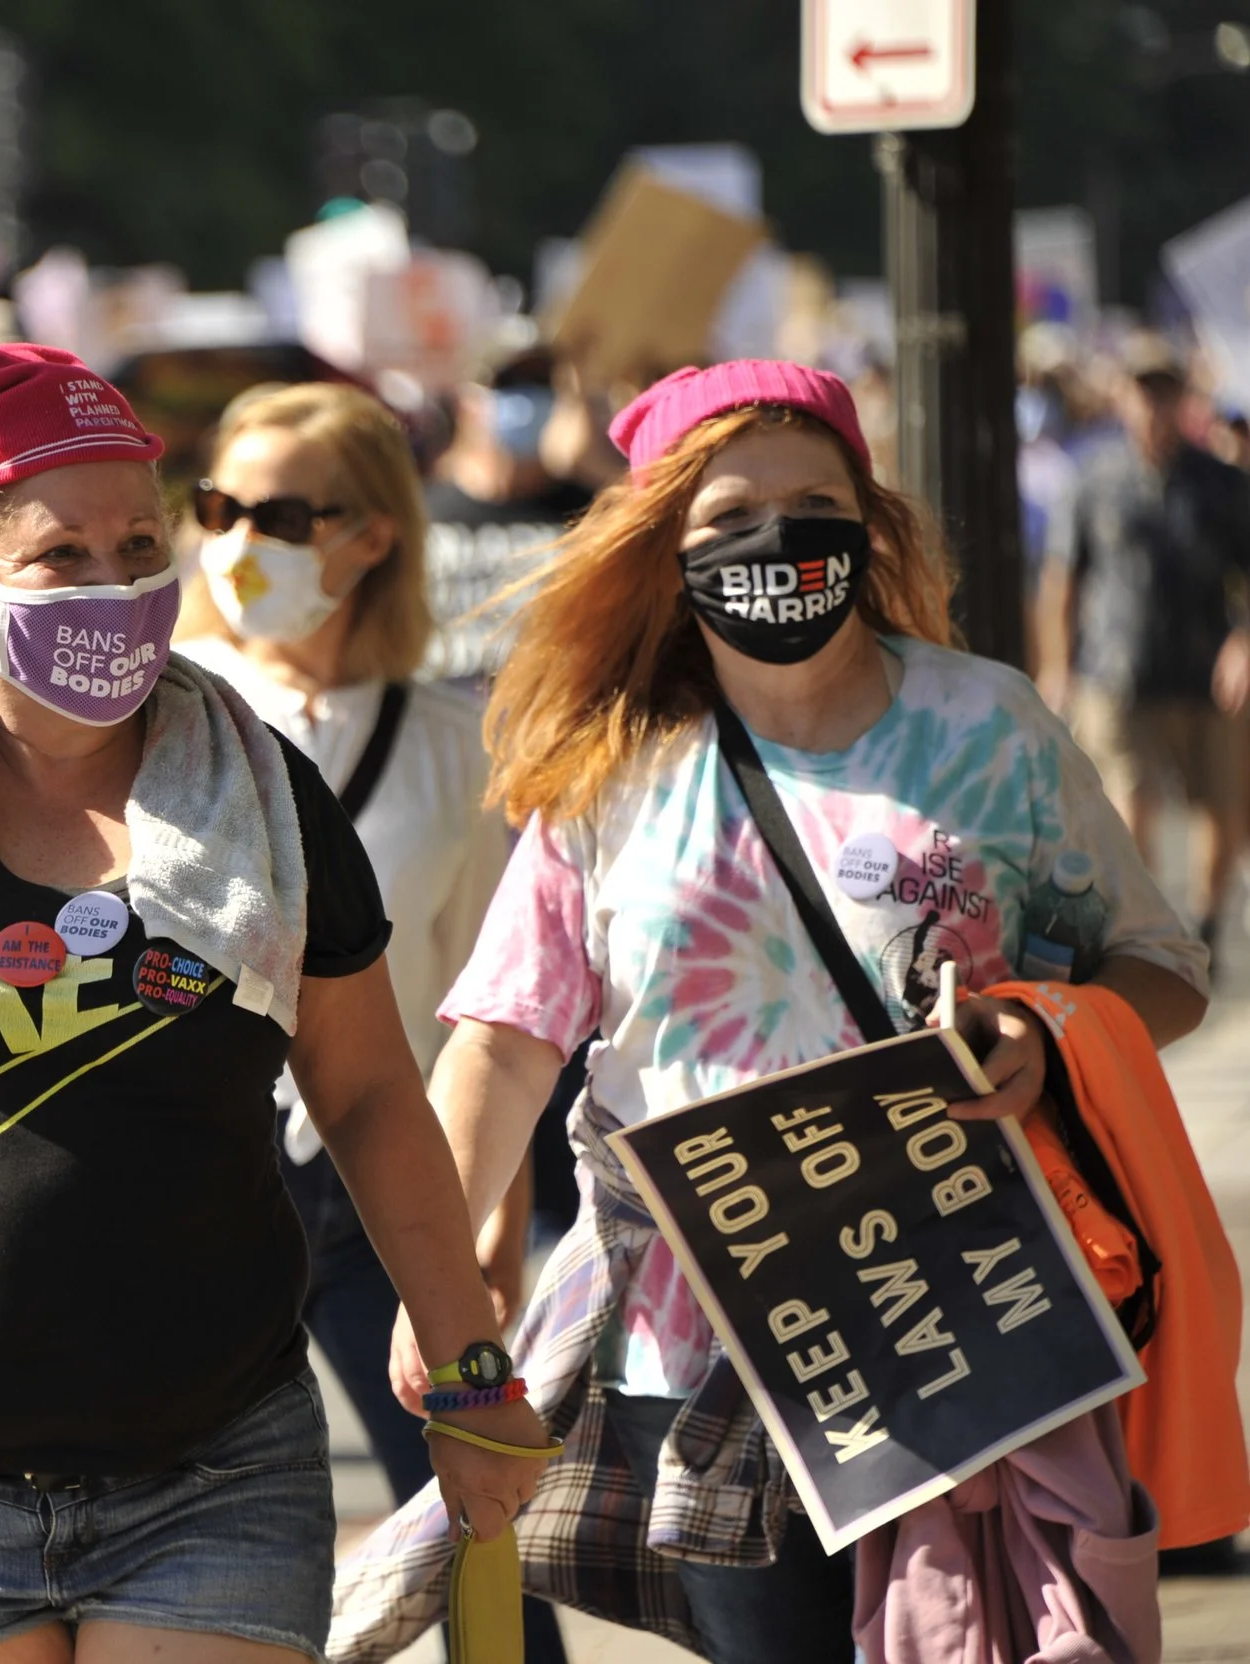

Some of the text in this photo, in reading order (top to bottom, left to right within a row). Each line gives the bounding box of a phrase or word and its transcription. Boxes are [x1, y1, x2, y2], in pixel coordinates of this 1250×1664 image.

[65, 392, 98, 405] WITH
[67, 379, 104, 391] STAND
[69, 404, 121, 417] PLANNED
[720, 551, 851, 597] BIDEN
[724, 581, 850, 624] HARRIS
[56, 625, 126, 654] BANS
[53, 642, 157, 677] OFF OUR
[50, 665, 146, 699] BODIES
[837, 869, 881, 883] BODIES
[863, 860, 890, 873] OUR
[67, 904, 101, 916] BANS
[876, 877, 993, 925] AGAINST
[25, 925, 30, 936] I
[60, 925, 109, 939] BODIES
[63, 914, 119, 930] OFF OUR
[2, 940, 50, 954] AM THE
[144, 949, 205, 979] PRO-CHOICE
[138, 966, 206, 995] PRO-VAXX
[136, 982, 199, 1009] PRO-EQUALITY
[770, 1104, 972, 1401] LAWS OFF
[672, 1125, 891, 1465] KEEP YOUR
[960, 1236, 1053, 1336] MY
